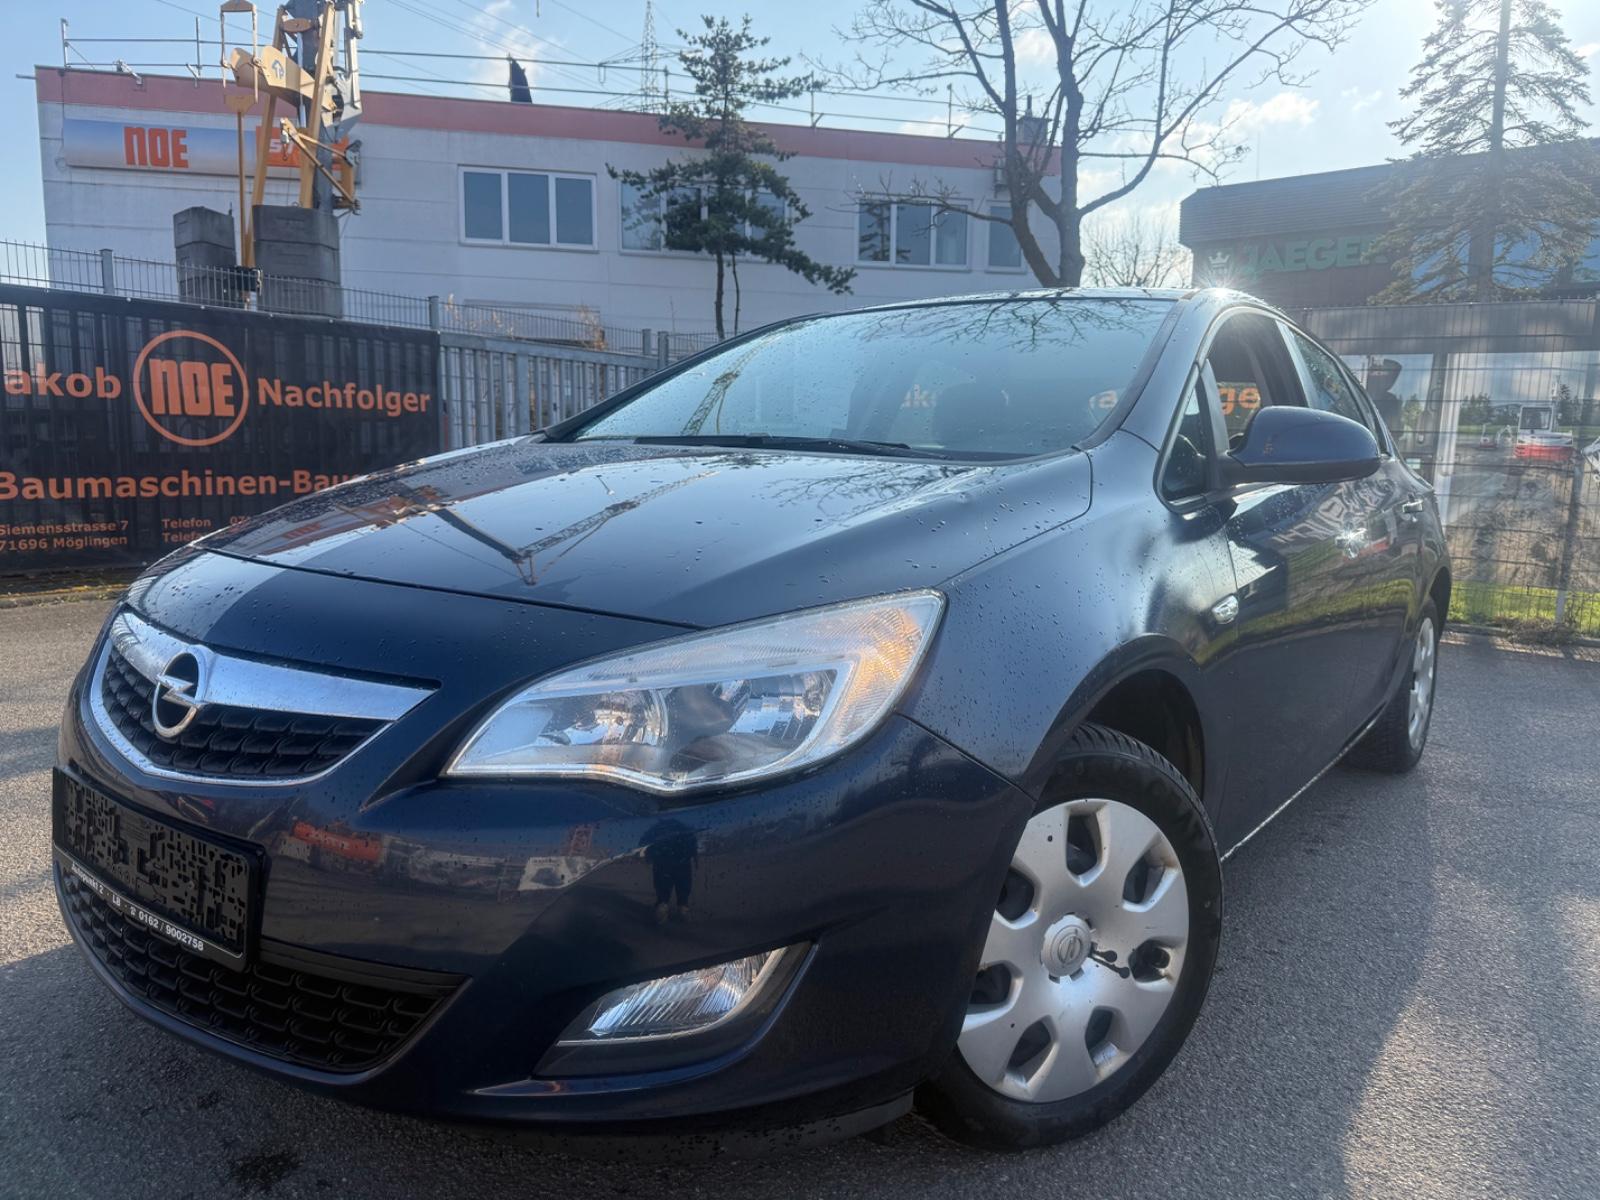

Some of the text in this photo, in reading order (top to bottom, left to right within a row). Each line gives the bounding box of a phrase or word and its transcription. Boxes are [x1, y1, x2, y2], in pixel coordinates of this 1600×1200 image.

[123, 126, 189, 169] NOE
[149, 358, 236, 417] NOE
[258, 377, 431, 417] Nachfolger
[0, 520, 129, 536] Siemensstrasse 7
[161, 517, 212, 529] Telefon
[0, 536, 129, 552] 71696 Möglingen
[138, 910, 159, 929] 0162
[165, 924, 204, 951] 9002758
